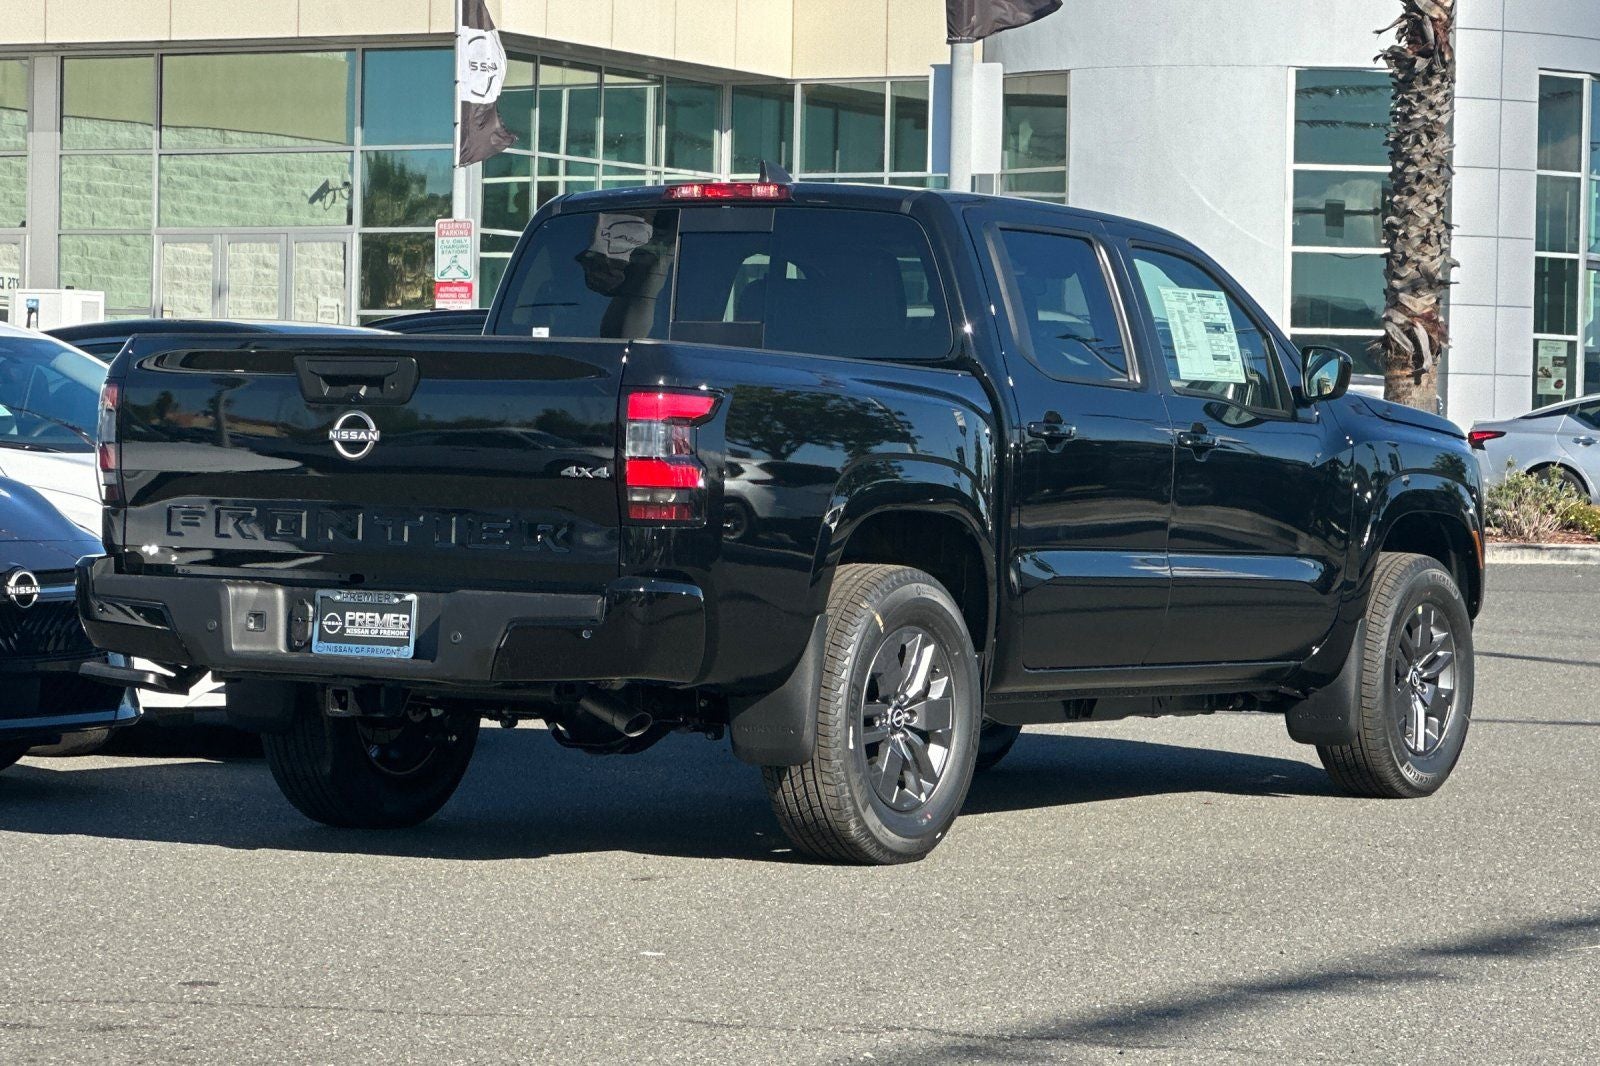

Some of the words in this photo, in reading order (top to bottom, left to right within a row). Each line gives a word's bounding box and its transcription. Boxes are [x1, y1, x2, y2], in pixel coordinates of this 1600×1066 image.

[440, 222, 471, 230] RESERVED
[441, 229, 468, 237] PARKING
[328, 429, 379, 441] NISSAN
[166, 504, 571, 554] FRONTIER
[7, 586, 41, 595] NISSAN
[342, 591, 392, 602] PREMIER
[345, 611, 410, 630] PREMIER
[326, 644, 353, 653] NISSAN
